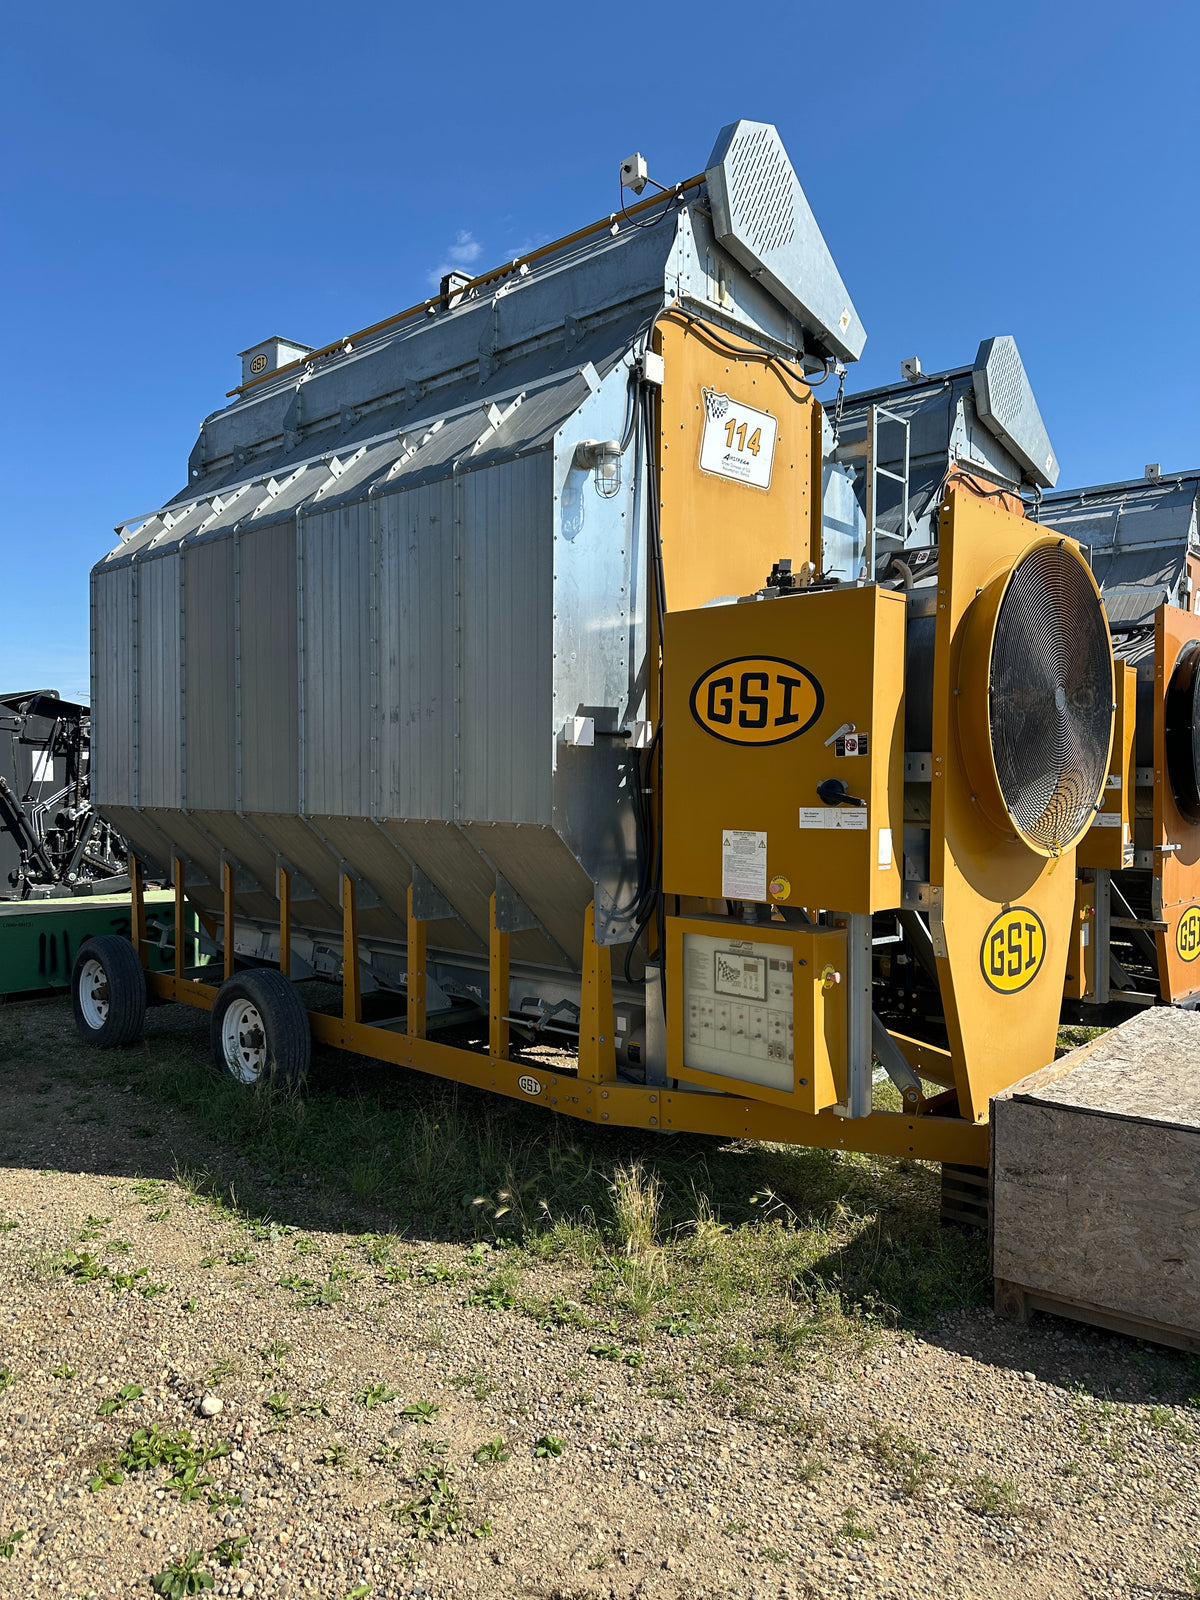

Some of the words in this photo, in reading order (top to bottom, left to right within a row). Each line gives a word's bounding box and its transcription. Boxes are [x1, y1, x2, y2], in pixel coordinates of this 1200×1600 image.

[252, 357, 265, 371] GSI
[724, 418, 761, 456] 114
[707, 672, 801, 728] GSI
[991, 922, 1036, 977] GSI
[521, 1078, 538, 1093] GSI
